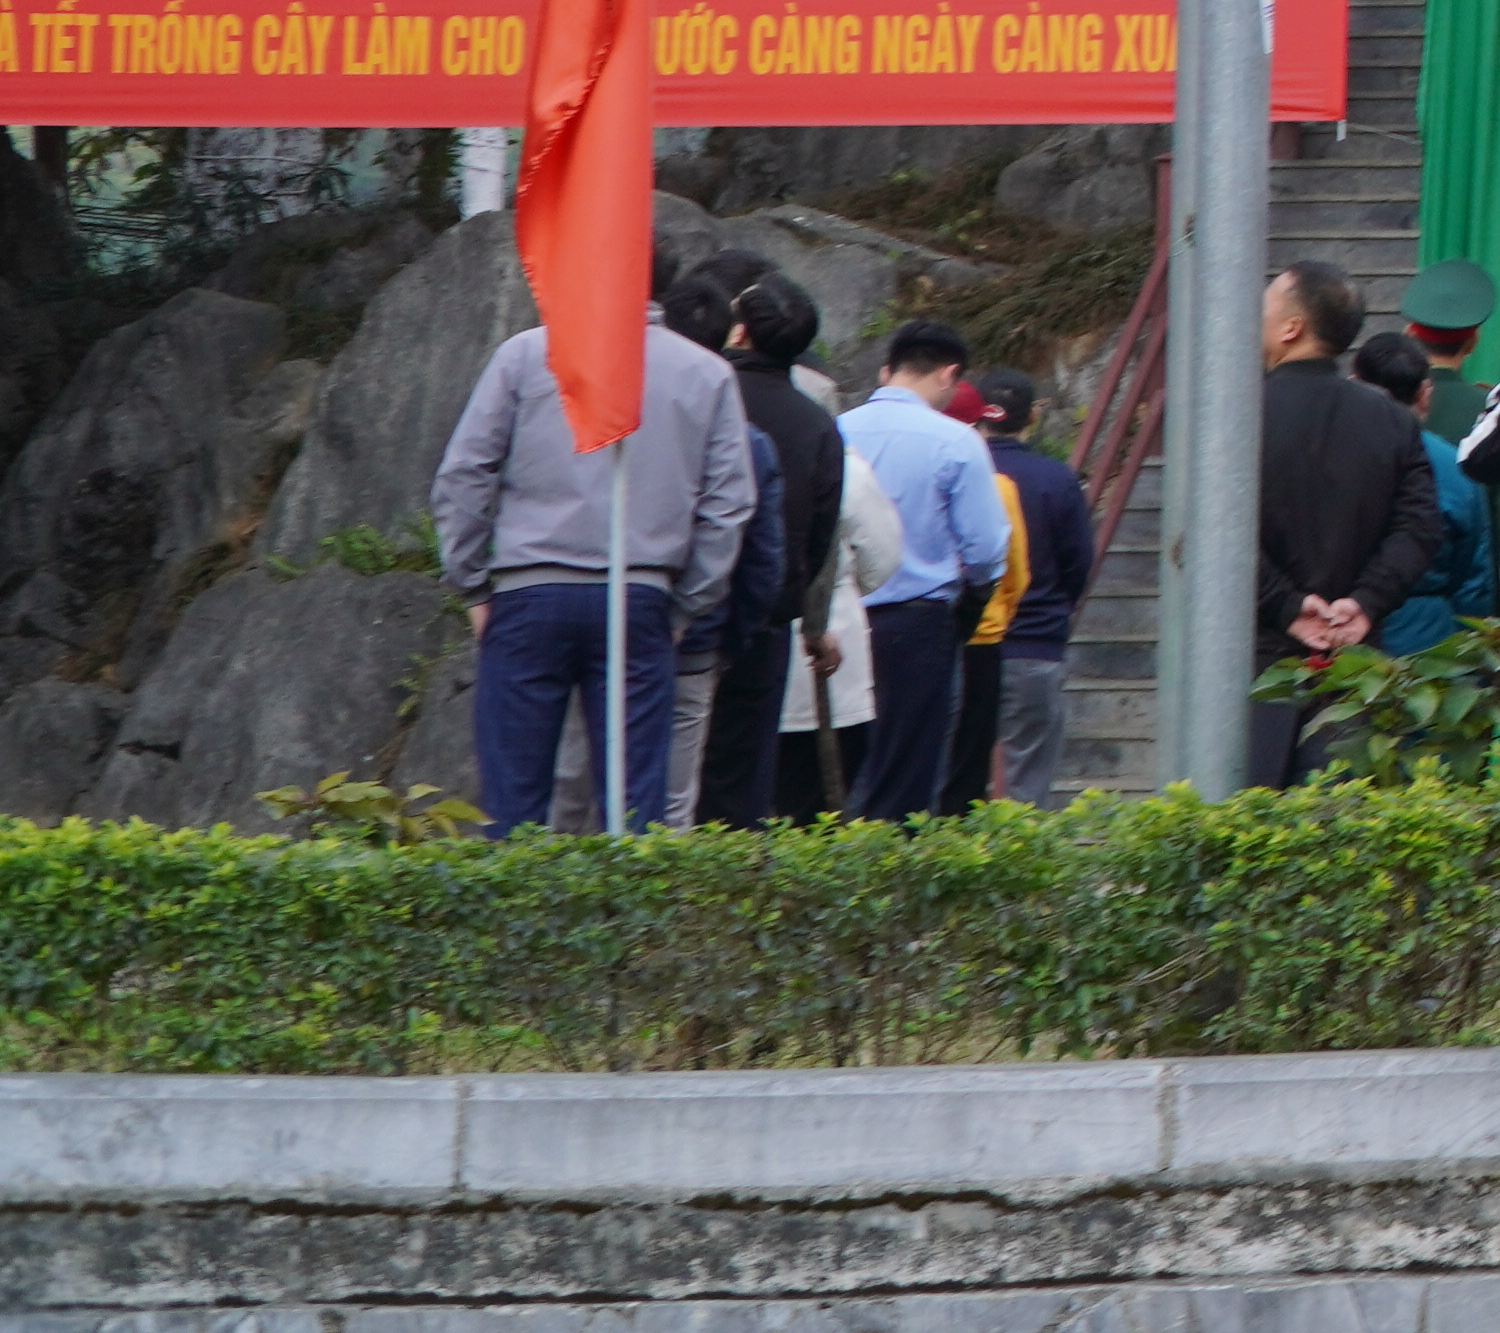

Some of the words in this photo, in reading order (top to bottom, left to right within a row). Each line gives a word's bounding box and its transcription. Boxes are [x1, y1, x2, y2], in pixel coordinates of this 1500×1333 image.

[252, 2, 334, 76] CÂY
[343, 2, 430, 76] LÀM
[442, 15, 526, 76] CHO
[654, 2, 738, 76] ƯỚC
[748, 2, 862, 76] CÀNG
[872, 2, 983, 75] NGÀY
[992, 1, 1104, 74] CÀNG
